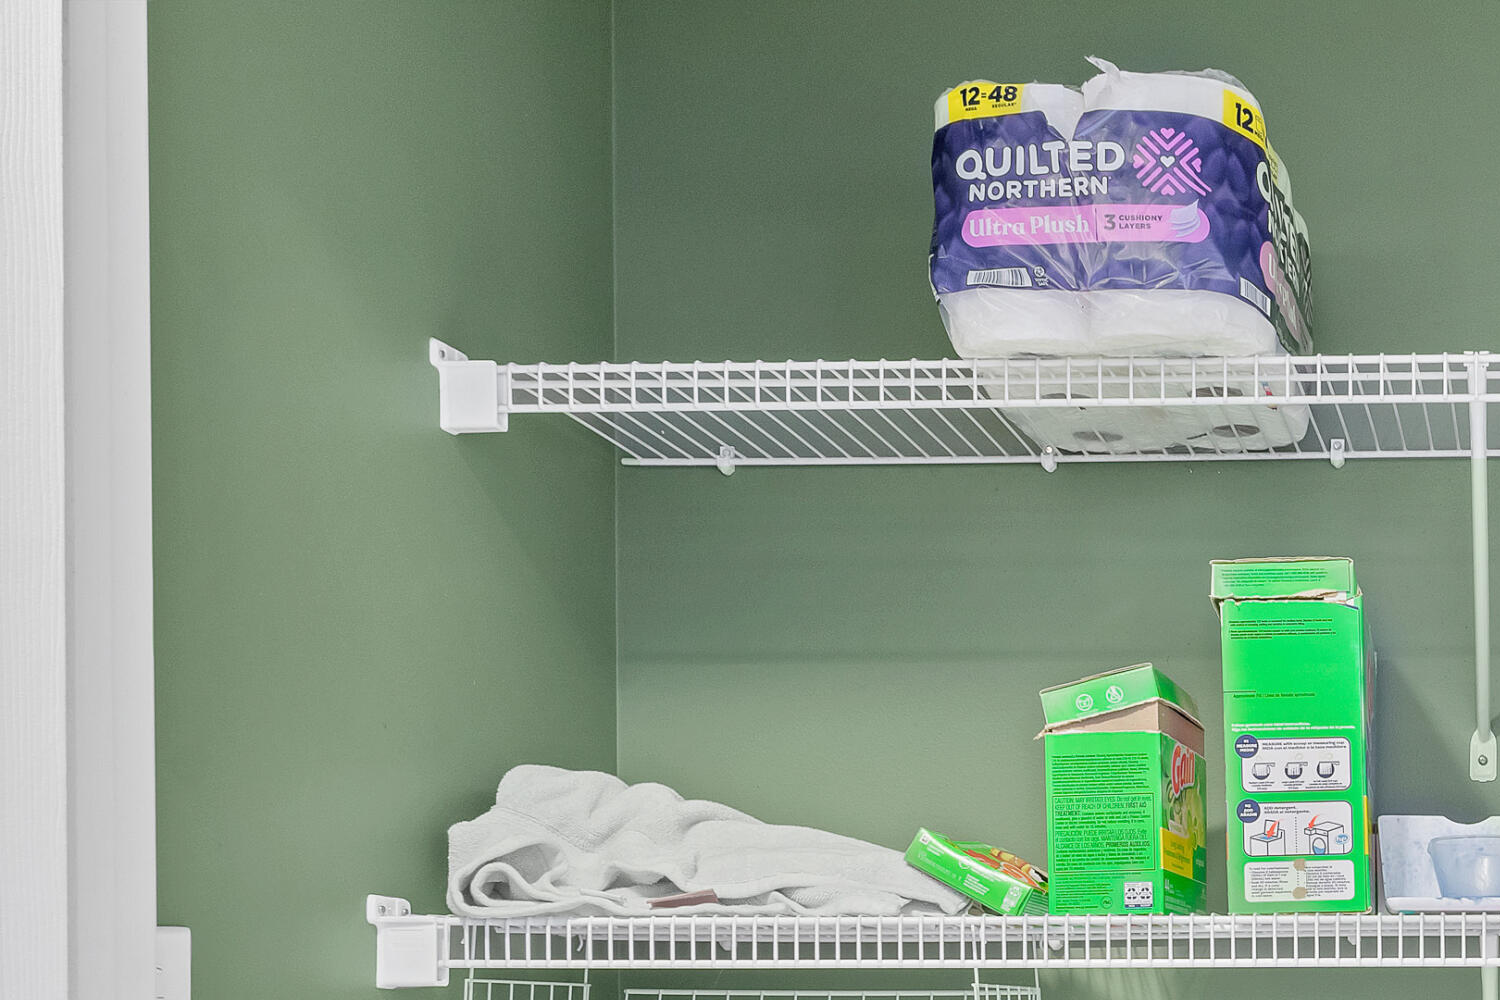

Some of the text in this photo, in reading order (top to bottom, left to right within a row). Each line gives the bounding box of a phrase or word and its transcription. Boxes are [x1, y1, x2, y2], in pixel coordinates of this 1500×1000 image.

[1235, 102, 1254, 133] 12
[955, 140, 1126, 181] QUILTED
[968, 175, 1113, 203] NORTHERN
[969, 213, 1091, 238] Ultra Plush
[1103, 213, 1116, 231] 3
[1118, 213, 1163, 223] CUSHIONY
[1118, 221, 1152, 231] LAYERS
[1172, 743, 1196, 797] Gain
